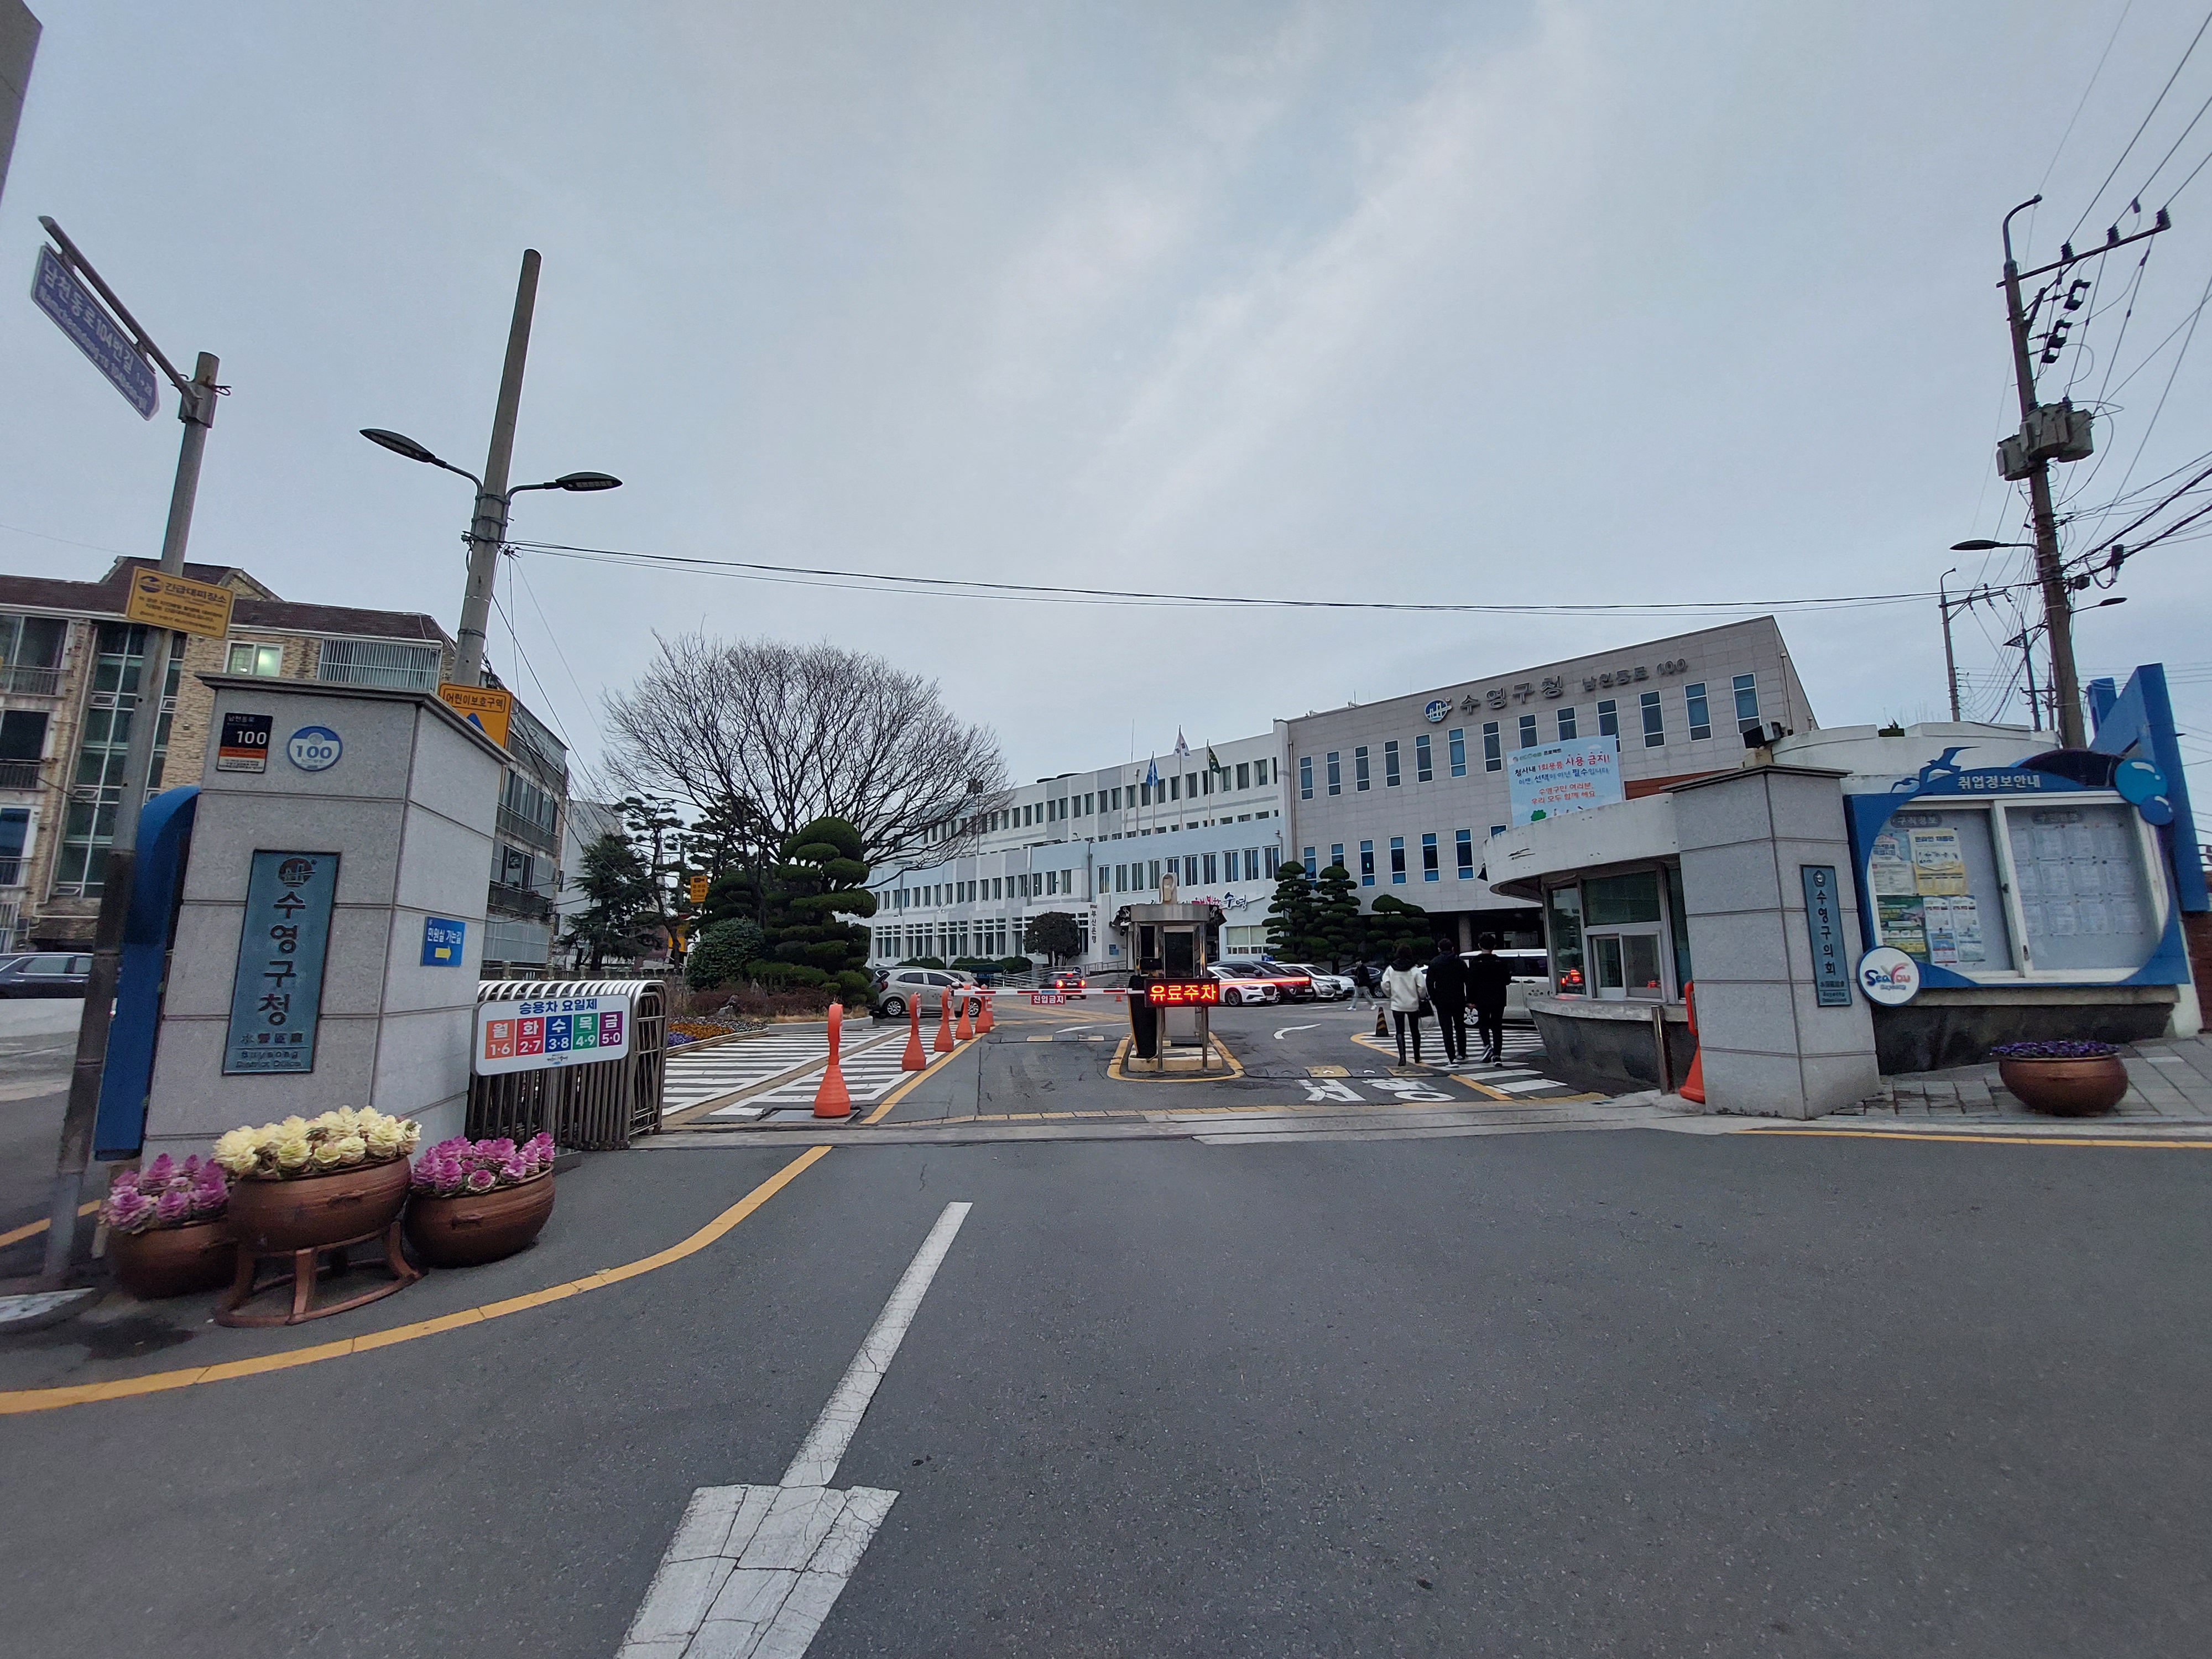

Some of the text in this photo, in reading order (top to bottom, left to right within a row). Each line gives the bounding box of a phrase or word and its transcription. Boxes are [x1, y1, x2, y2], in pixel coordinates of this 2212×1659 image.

[45, 260, 134, 374] 남천동로104번길
[165, 582, 227, 603] 긴급대피장소
[1459, 675, 1564, 714] 수영구청
[1656, 658, 1689, 676] 100
[446, 692, 503, 709] 어린이보호구역
[237, 731, 267, 745] 100
[296, 745, 332, 759] 100
[1515, 753, 1610, 777] 청사내 1회용품 사용 금지!
[1534, 773, 1556, 783] 선택이
[1957, 775, 2041, 790] 취업정보안내
[1538, 785, 1567, 795] 수영구민
[1564, 792, 1579, 800] 함께
[1223, 891, 1247, 910] 수영
[427, 927, 462, 945] 민원실 가는길
[1816, 889, 1836, 976] 수영구의회
[258, 891, 306, 1026] 수영구청
[1033, 995, 1064, 1004] 진입금지
[1150, 984, 1217, 1001] 유료주차
[519, 998, 598, 1015] 승용차 요일제
[523, 1020, 539, 1036] 화
[551, 1019, 567, 1034] 수
[578, 1016, 593, 1030] 목
[604, 1014, 618, 1029] 금
[492, 1022, 508, 1039] 월
